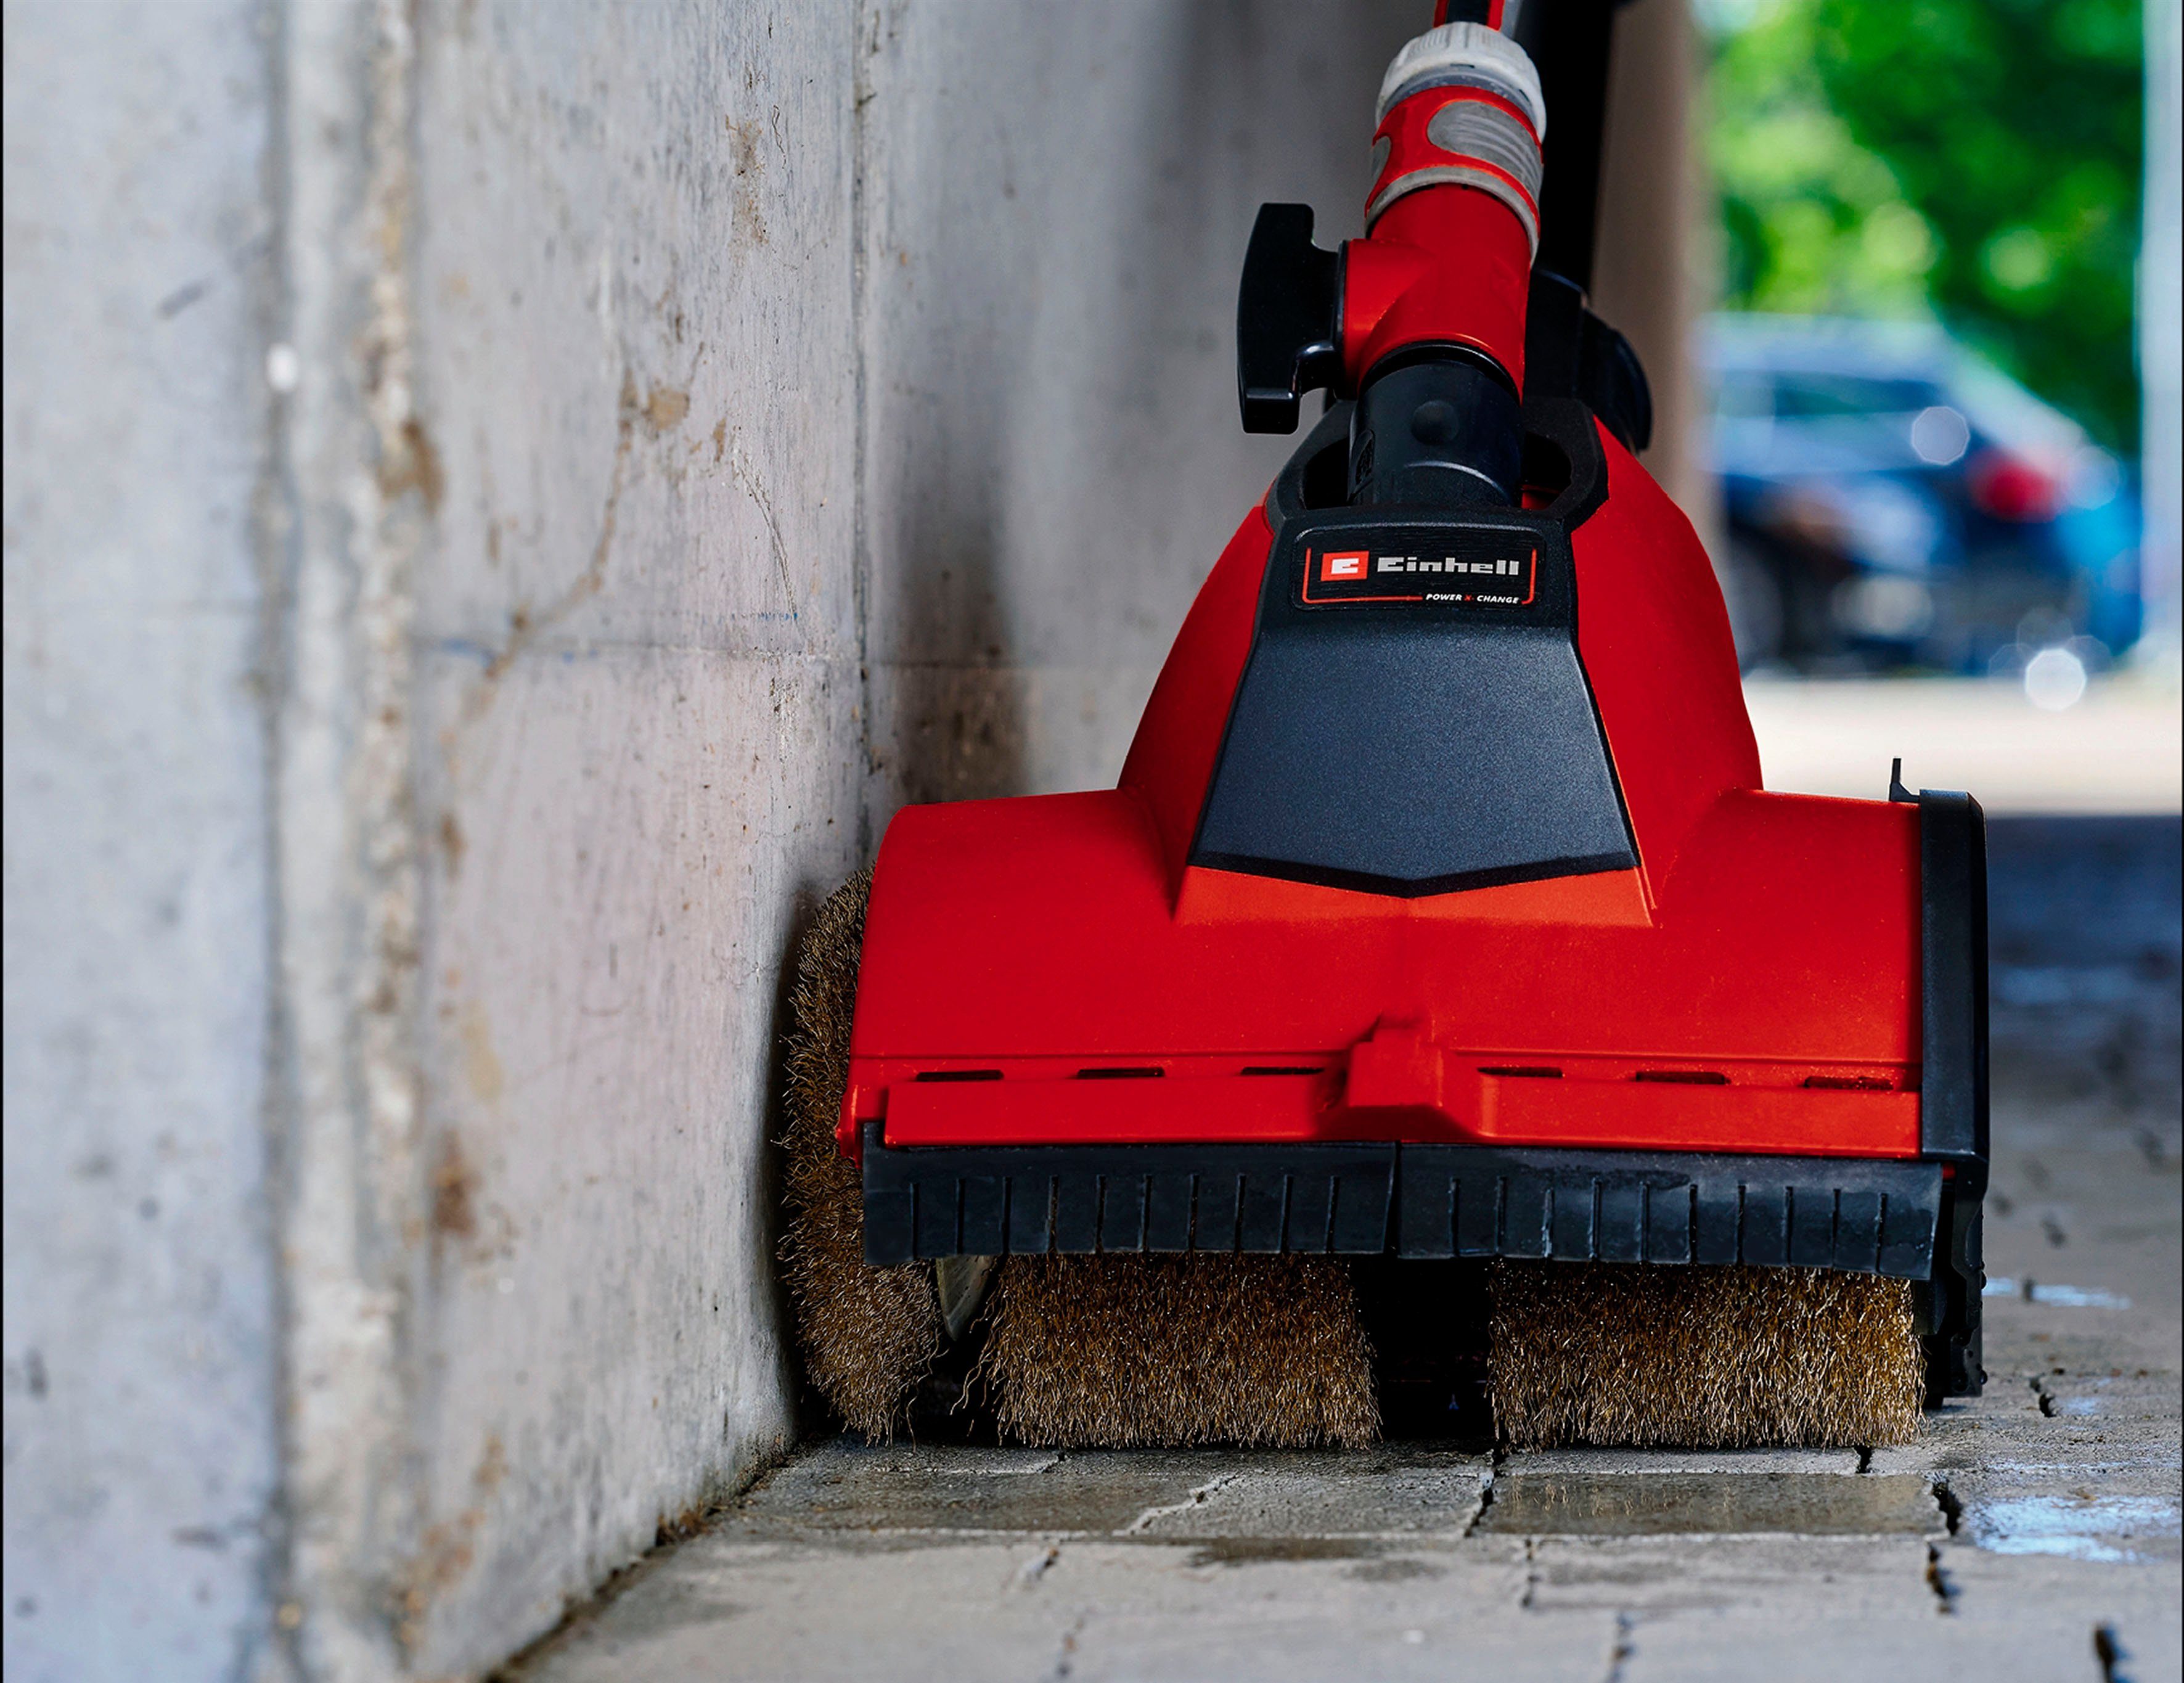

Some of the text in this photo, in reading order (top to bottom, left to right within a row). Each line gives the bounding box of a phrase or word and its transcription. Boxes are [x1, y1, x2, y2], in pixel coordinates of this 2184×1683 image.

[1377, 557, 1519, 575] Einhell
[1426, 593, 1462, 601] POWER
[1476, 595, 1519, 604] CHANGE
